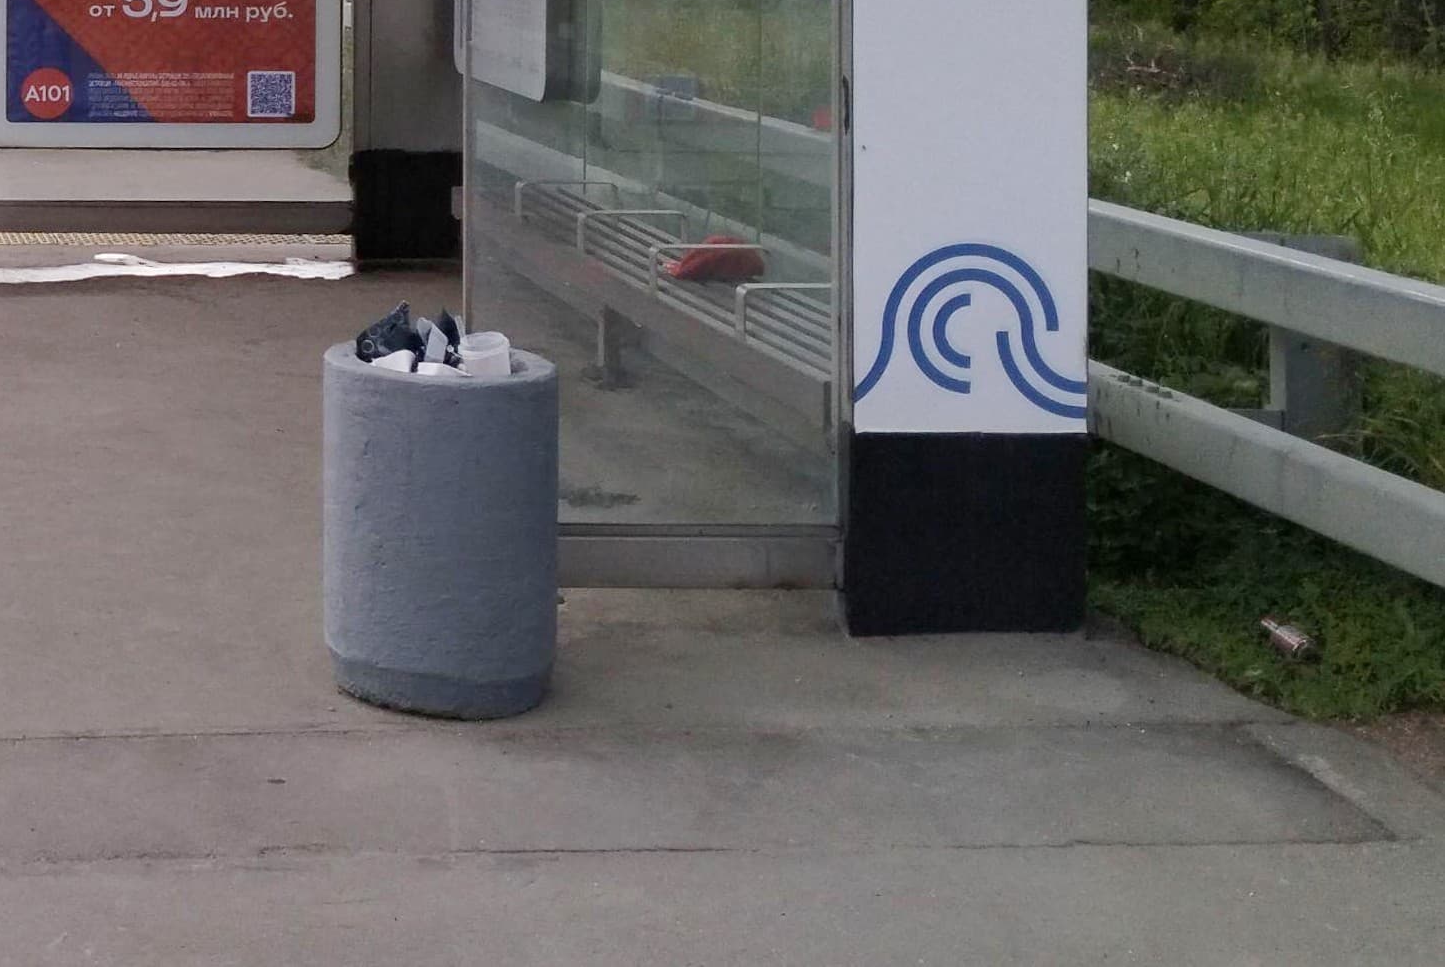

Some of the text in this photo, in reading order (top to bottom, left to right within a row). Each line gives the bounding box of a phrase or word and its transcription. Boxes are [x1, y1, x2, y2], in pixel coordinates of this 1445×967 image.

[88, 5, 115, 18] от
[194, 6, 239, 19] млн
[245, 1, 294, 23] руб.
[24, 84, 71, 103] А101
